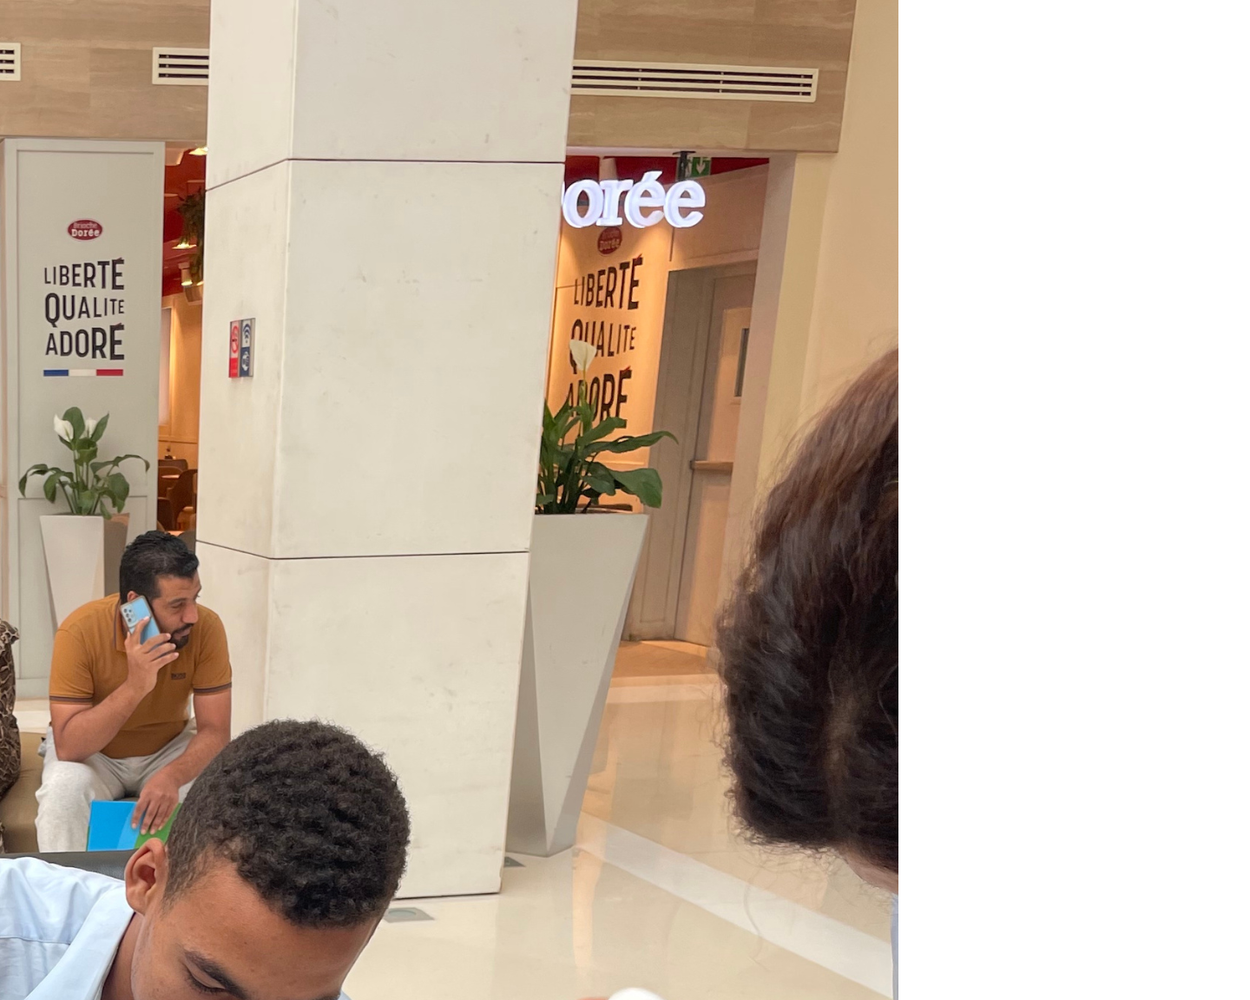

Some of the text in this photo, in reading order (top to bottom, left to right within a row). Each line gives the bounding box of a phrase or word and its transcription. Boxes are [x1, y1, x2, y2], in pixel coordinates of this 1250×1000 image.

[561, 171, 706, 229] orée
[44, 257, 125, 290] LIBERTÉ
[573, 254, 643, 310] LIBERTÉ
[44, 292, 125, 328] QUALITE
[45, 322, 125, 360] ADORÉ
